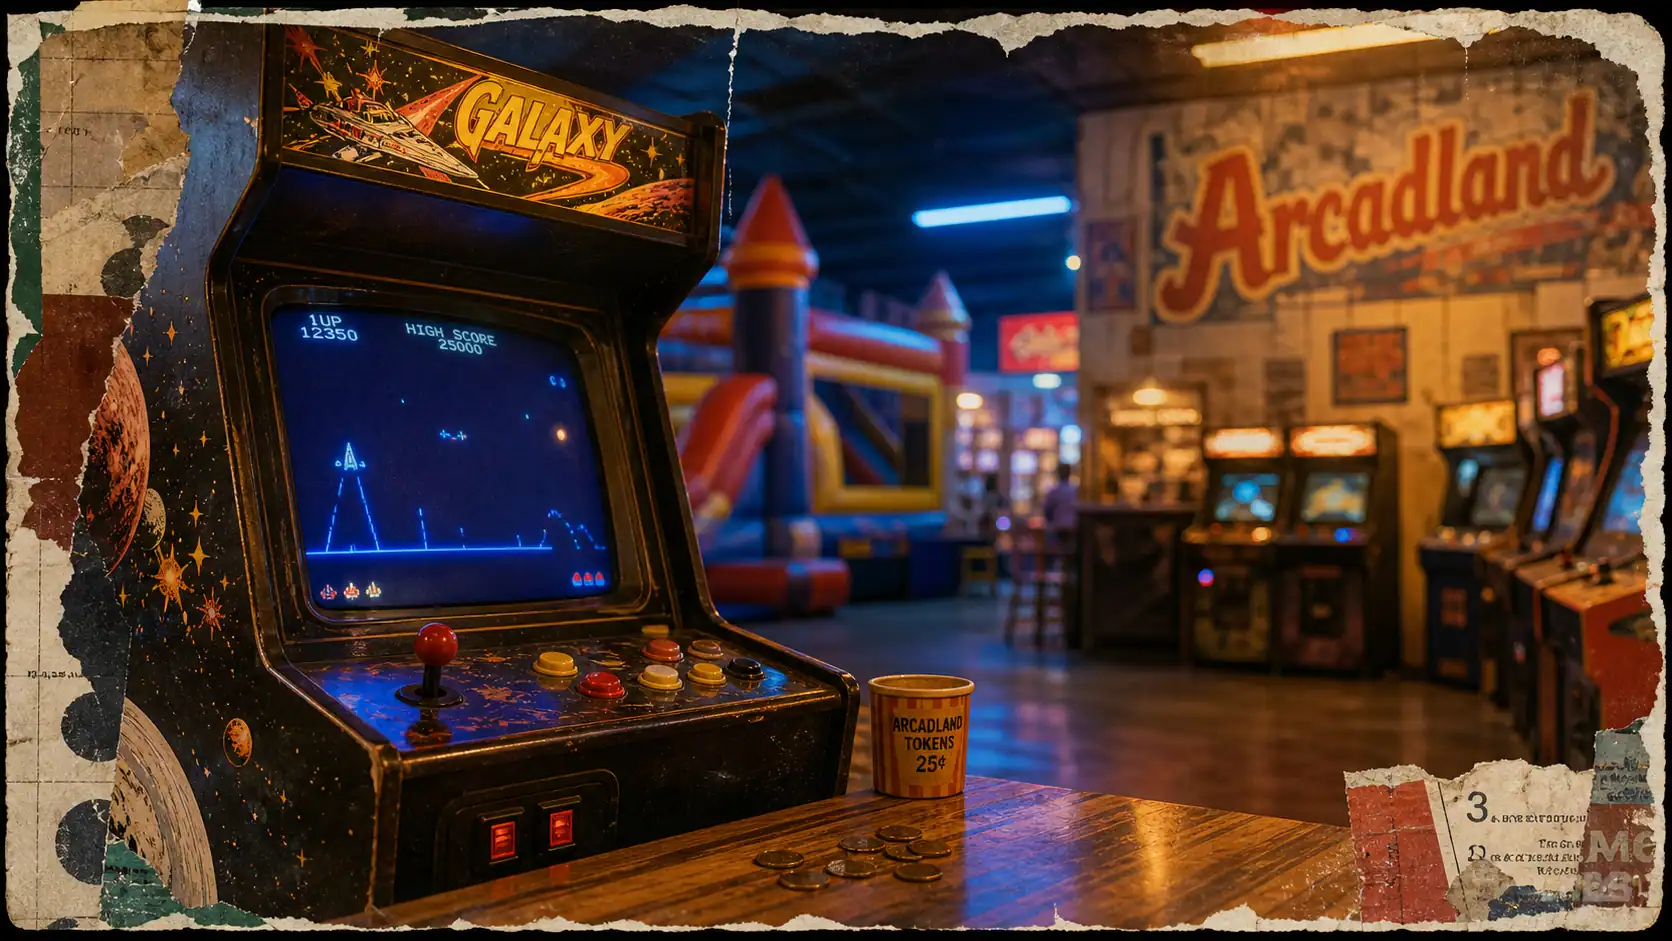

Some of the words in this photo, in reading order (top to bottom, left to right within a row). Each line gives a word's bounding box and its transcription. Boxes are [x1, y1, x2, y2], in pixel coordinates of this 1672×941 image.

[454, 78, 633, 172] GALAXY
[1155, 89, 1615, 321] Arcadland
[309, 314, 342, 327] 1UP
[301, 326, 358, 341] 12350
[405, 322, 444, 338] HIGH
[453, 329, 497, 347] SCORE
[438, 338, 483, 355] 25000
[893, 716, 963, 733] ARCADLAND
[904, 735, 955, 750] TOKENS
[916, 755, 946, 773] 25¢
[1467, 791, 1488, 823] 3
